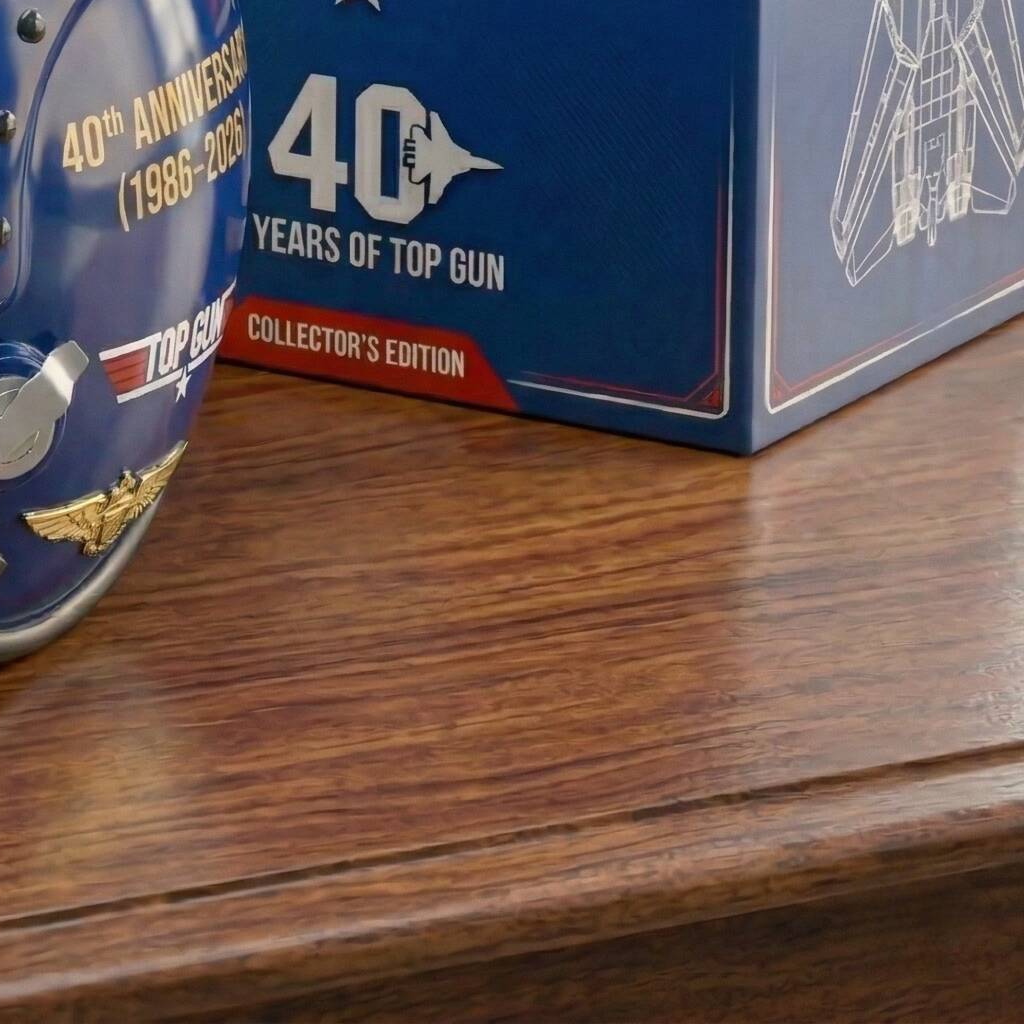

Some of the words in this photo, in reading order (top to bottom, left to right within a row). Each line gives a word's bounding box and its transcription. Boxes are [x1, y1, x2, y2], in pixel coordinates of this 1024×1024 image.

[62, 104, 125, 173] 40th
[132, 23, 248, 151] ANNIVERSAR
[267, 73, 427, 226] 40
[252, 212, 341, 264] YEARS
[349, 231, 382, 270] OF
[388, 237, 442, 279] TOP
[449, 247, 505, 291] GUN
[145, 319, 191, 383] TOP
[189, 294, 227, 359] GUN
[247, 313, 380, 363] COLLECTOR'S
[385, 338, 465, 378] EDITION
